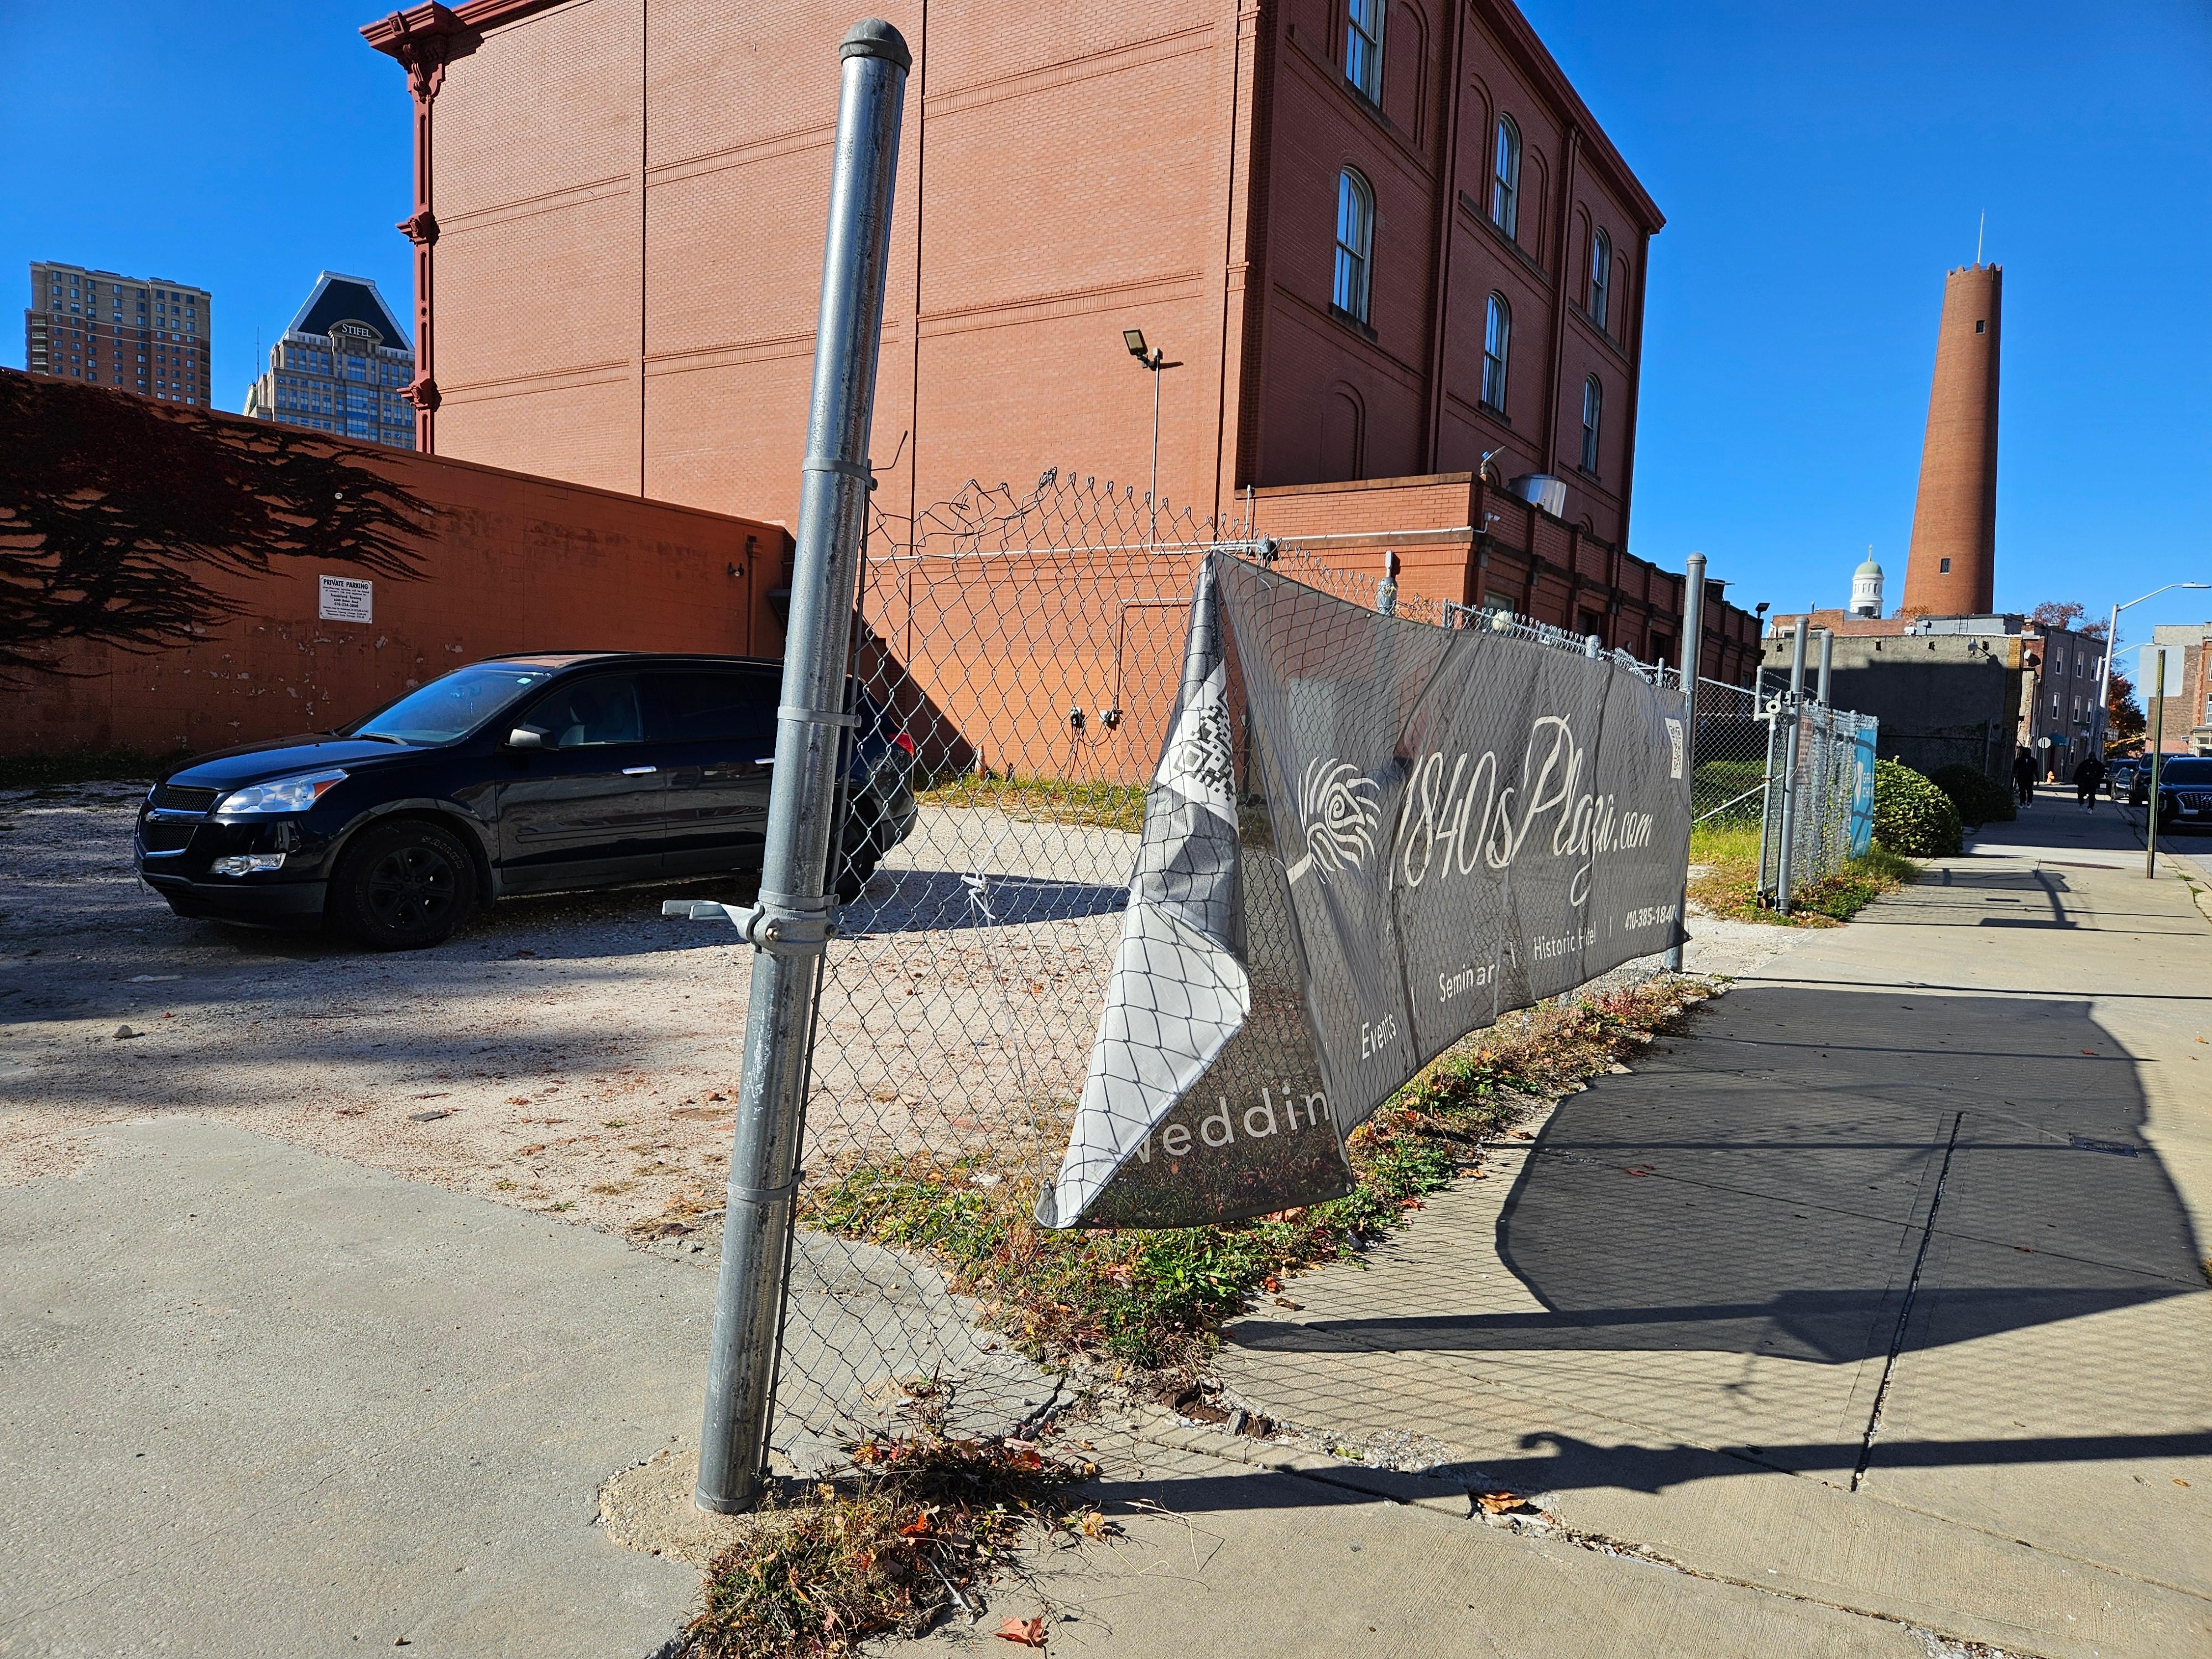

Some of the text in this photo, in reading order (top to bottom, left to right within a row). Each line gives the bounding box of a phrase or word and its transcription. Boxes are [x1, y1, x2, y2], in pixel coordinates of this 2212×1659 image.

[342, 324, 371, 337] STIFEL
[1136, 1086, 1330, 1164] eddin
[1362, 1010, 1396, 1060] Events
[1438, 962, 1500, 1003] Seminar
[1533, 929, 1575, 961] Historic
